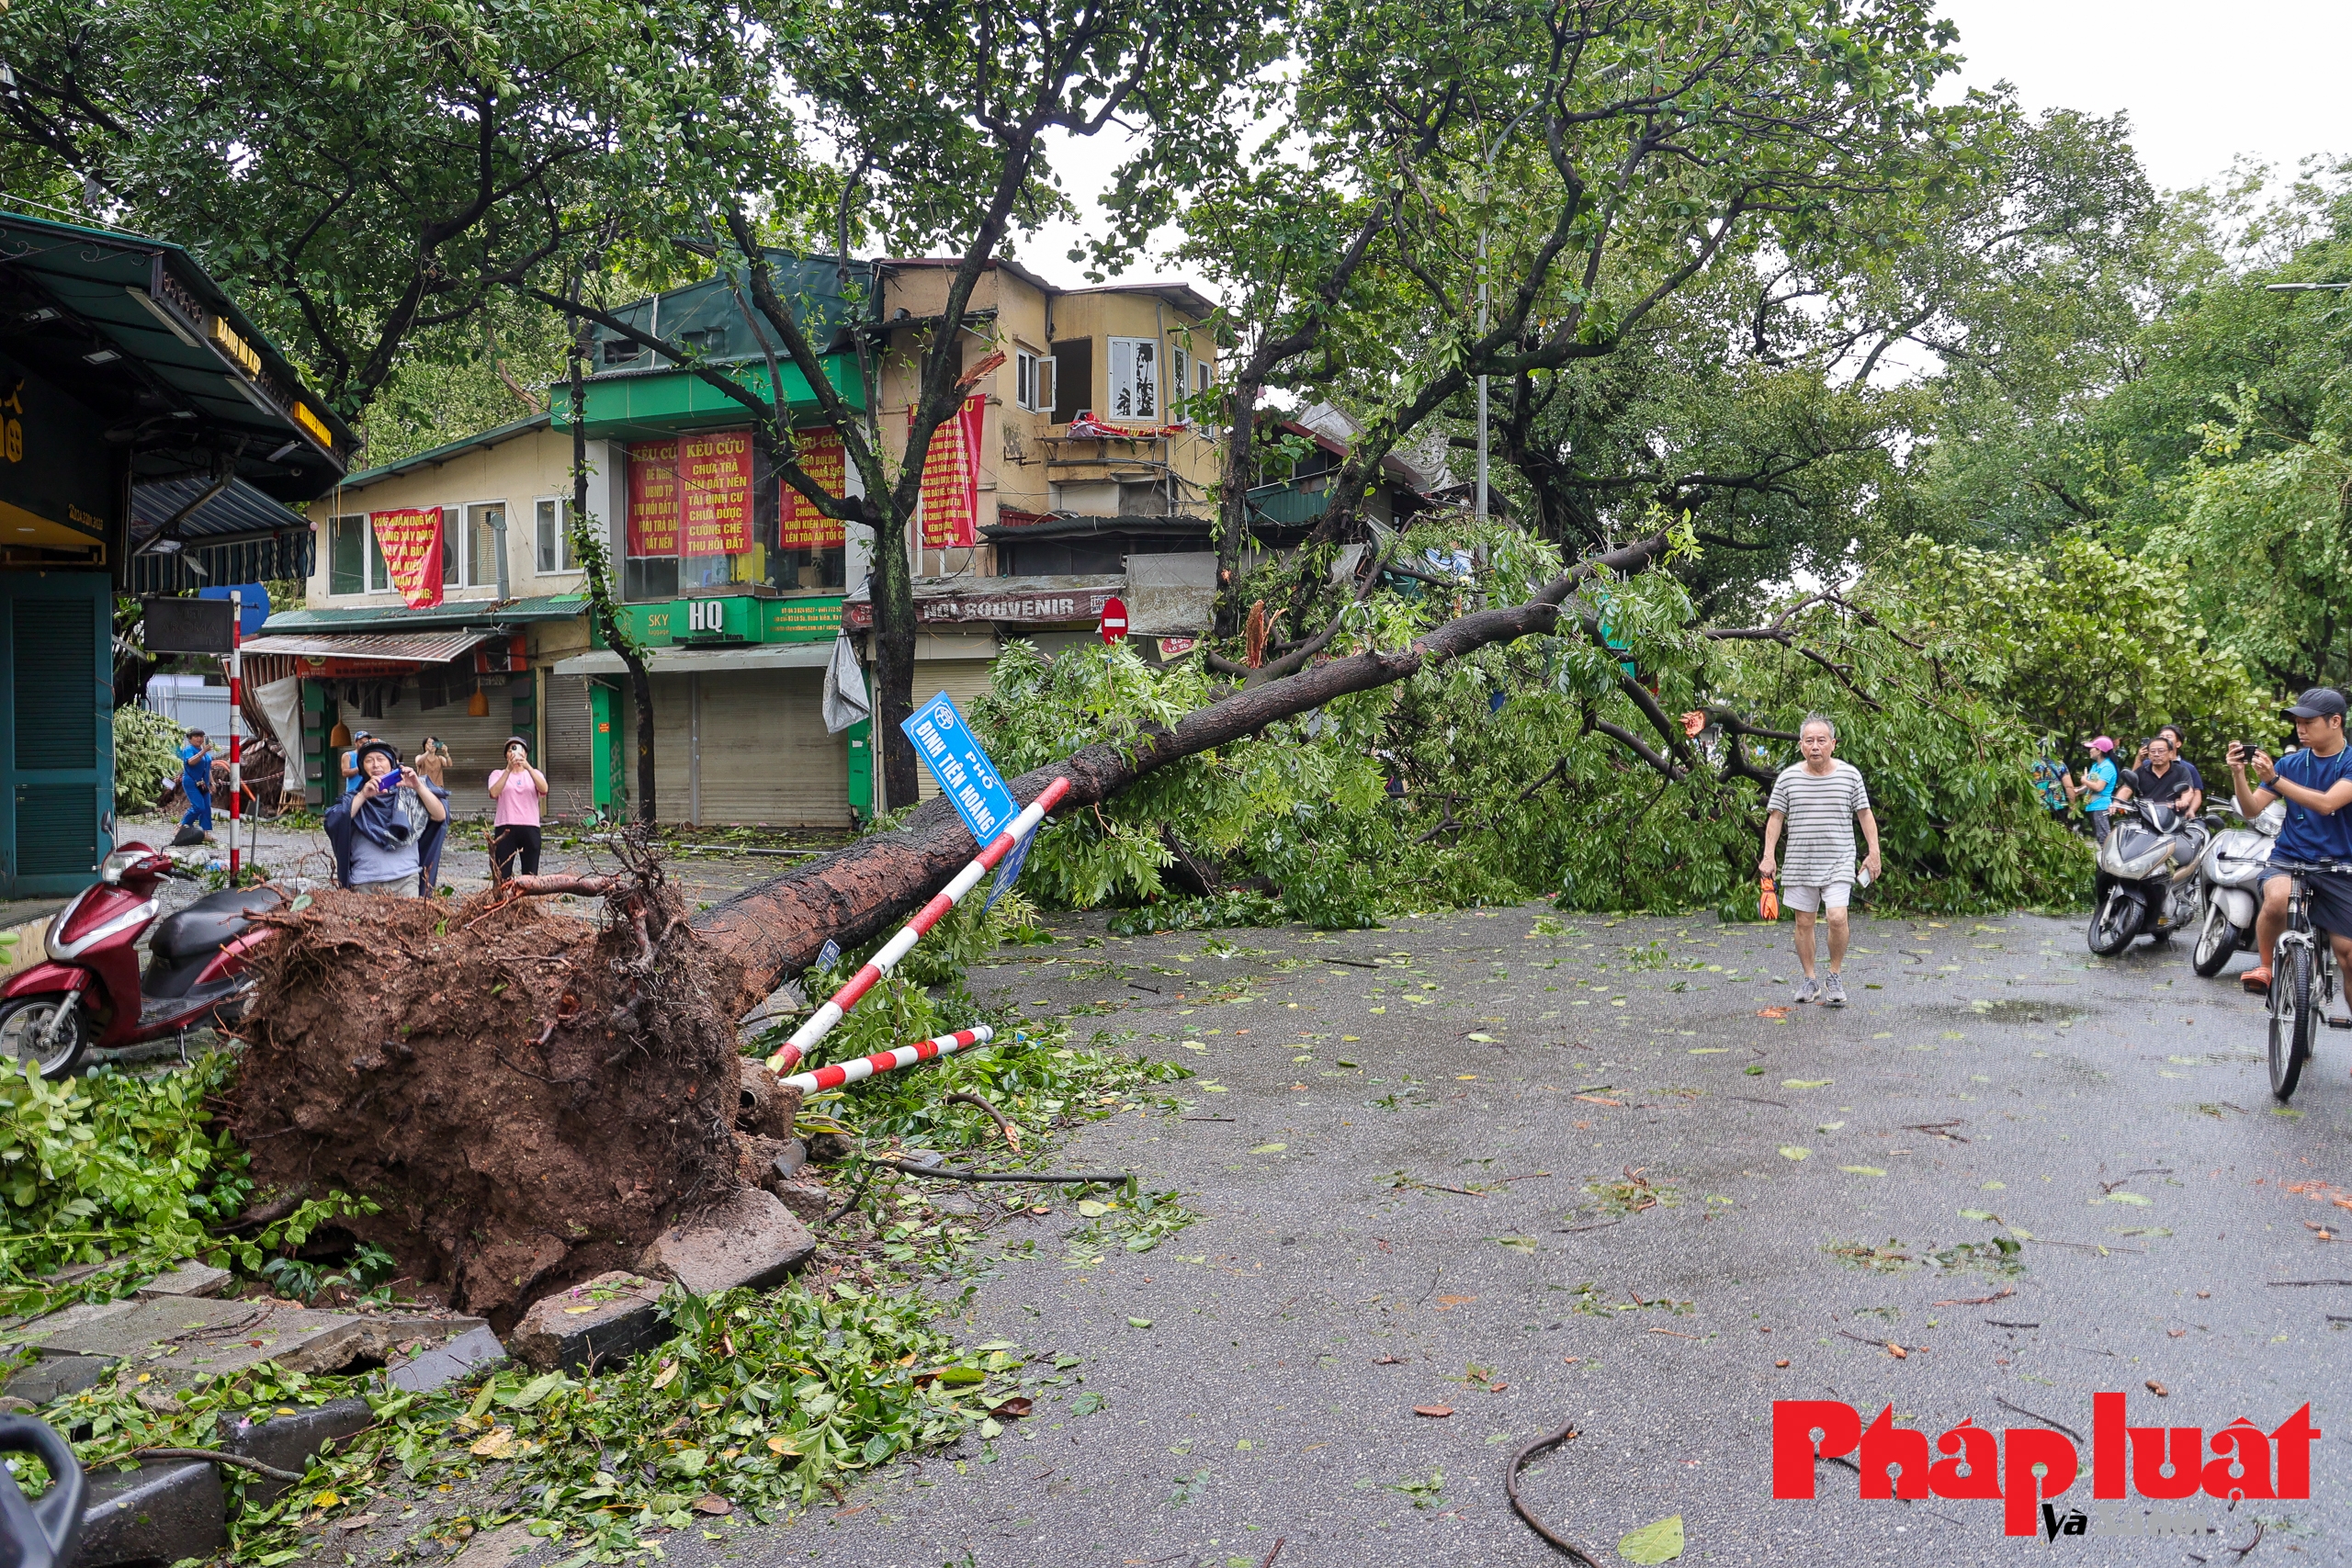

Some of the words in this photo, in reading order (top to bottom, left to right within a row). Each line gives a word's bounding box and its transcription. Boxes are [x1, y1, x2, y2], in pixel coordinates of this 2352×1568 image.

[660, 443, 678, 460] CỨ
[686, 440, 713, 458] KÊU
[716, 437, 745, 456] CỨU
[692, 463, 718, 476] CHƯA
[720, 458, 739, 473] TRẢ
[707, 475, 725, 491] ĐẤT
[727, 473, 747, 489] NỀN
[645, 485, 664, 498] UBND
[664, 484, 674, 497] TP
[688, 493, 704, 506] TÁI
[706, 494, 728, 507] ĐỊNH
[730, 491, 744, 503] CƯ
[673, 502, 678, 513] N
[689, 508, 714, 522] CHƯA
[716, 507, 742, 521] ĐƯỢC
[796, 505, 820, 517] CHÚNG
[653, 515, 667, 532] TRẢ
[688, 523, 721, 536] CƯỠNG
[723, 520, 743, 535] CHẾ
[785, 517, 801, 531] KHỞI
[802, 517, 819, 531] KIỆN
[687, 540, 707, 552] THU
[707, 536, 723, 551] HỒI
[725, 535, 745, 550] ĐẤT
[786, 531, 798, 544] LÊN
[814, 529, 824, 542] ÁN
[825, 527, 837, 541] TỐI
[689, 600, 723, 633] HQ
[964, 598, 1074, 618] SOUVENIR
[648, 614, 670, 627] SKY
[648, 628, 670, 637] luggage
[915, 719, 947, 759] ĐINH
[938, 752, 967, 790] TIÊN
[958, 783, 996, 833] HOÀNG
[965, 750, 999, 790] PHỐ
